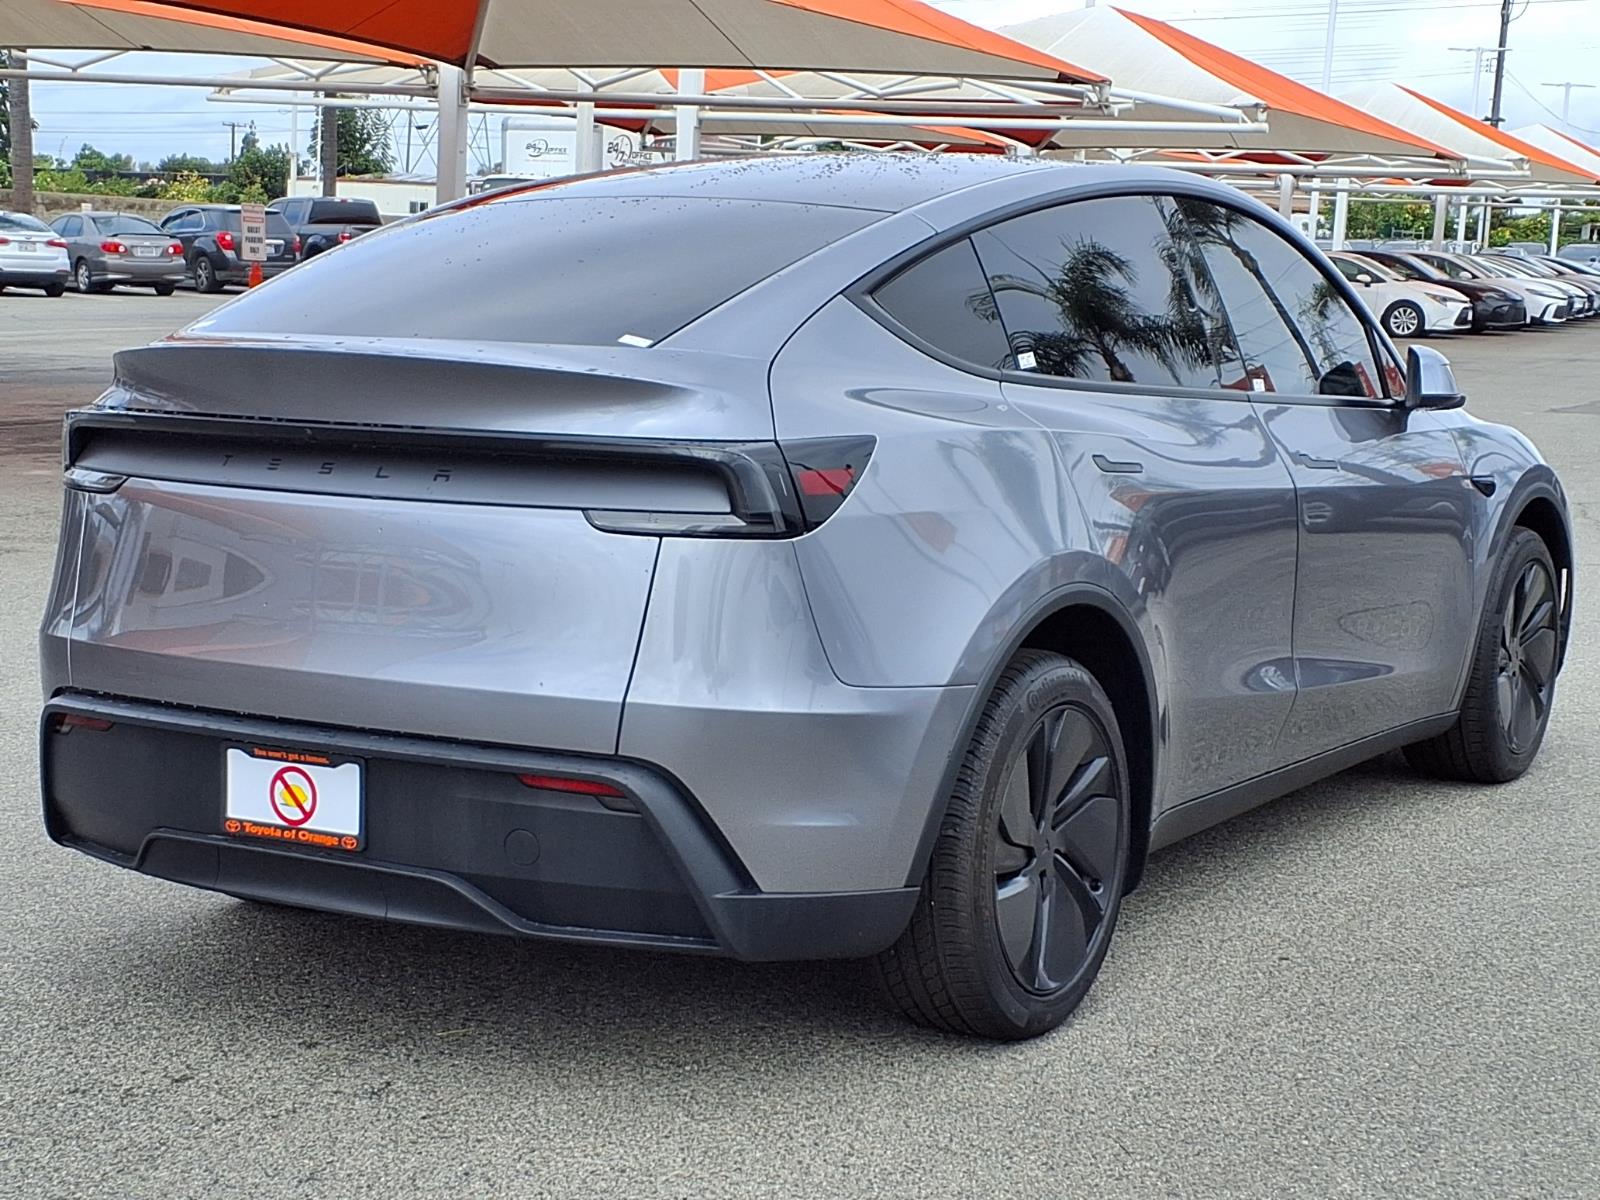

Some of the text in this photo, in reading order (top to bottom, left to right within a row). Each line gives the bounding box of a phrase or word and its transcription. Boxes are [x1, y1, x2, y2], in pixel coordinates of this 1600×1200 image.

[607, 141, 653, 162] 24/7 OFFICE
[222, 455, 452, 482] TESLA
[243, 821, 339, 847] Toyota of Orange
